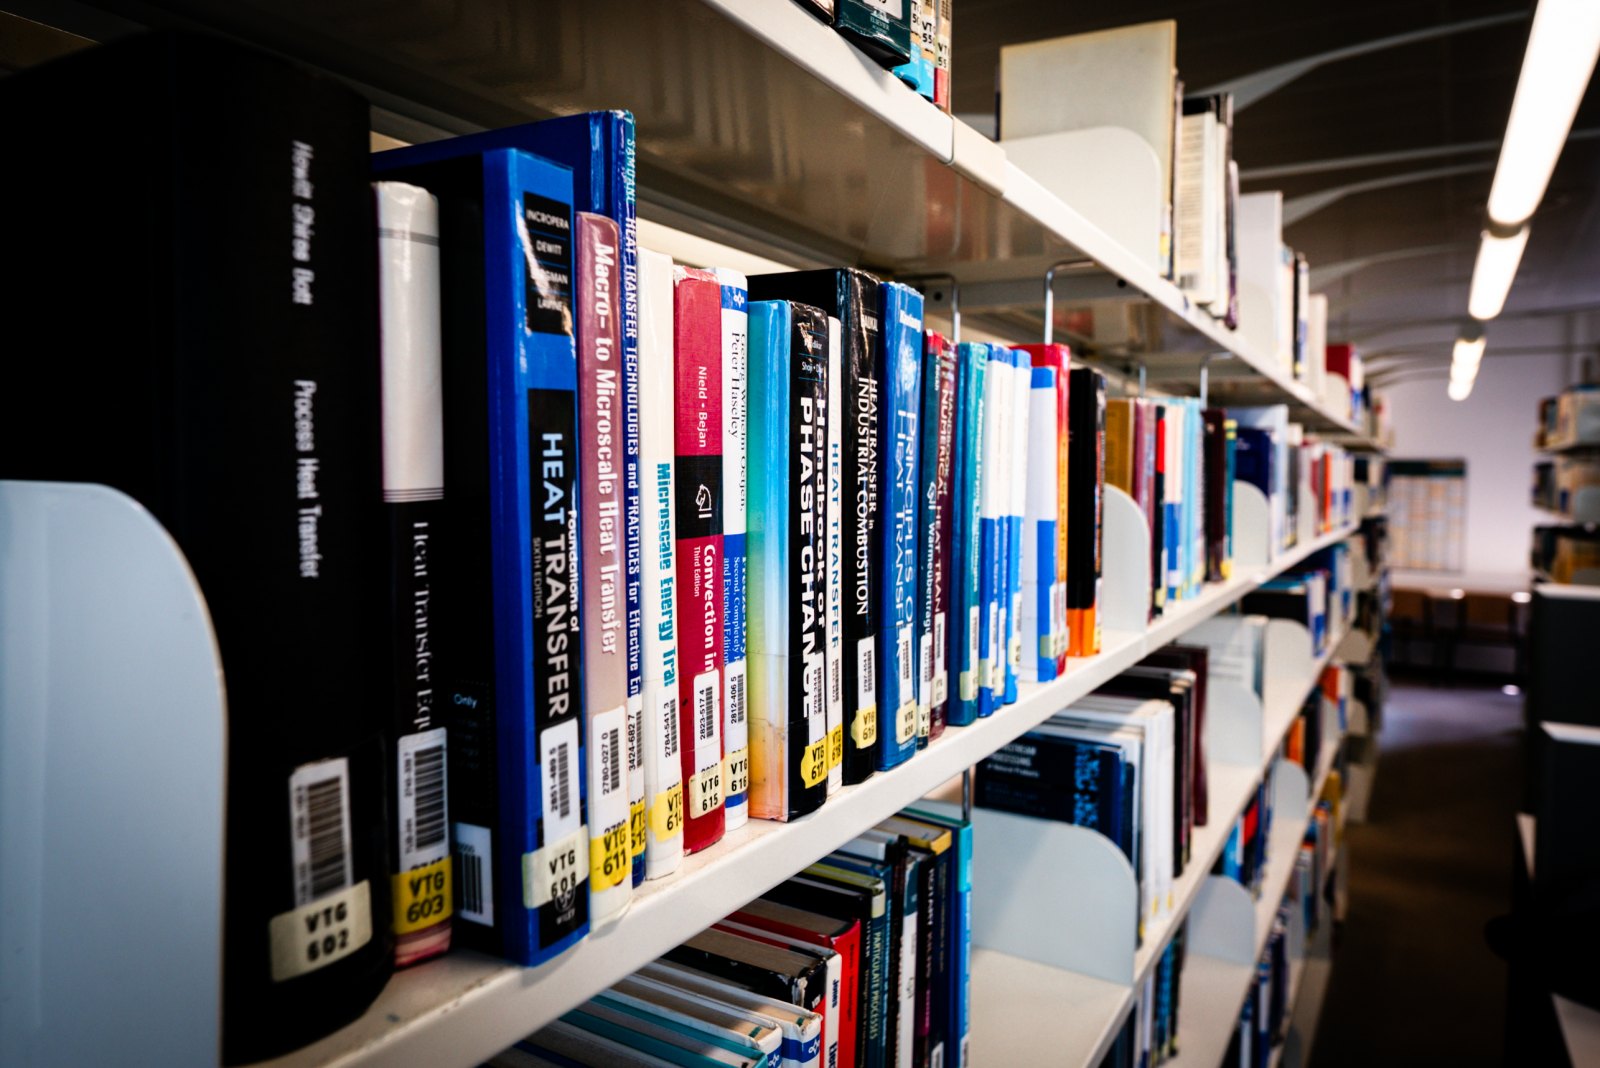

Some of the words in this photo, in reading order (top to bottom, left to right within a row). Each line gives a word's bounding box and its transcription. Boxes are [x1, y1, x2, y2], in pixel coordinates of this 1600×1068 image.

[526, 208, 570, 231] INCROPERA
[625, 216, 637, 263] HEAT
[625, 264, 638, 338] TRANSFER
[595, 337, 613, 362] to
[731, 332, 740, 371] Peter
[625, 347, 639, 456] TECHNOLOGIES
[698, 366, 708, 399] Nield
[868, 379, 879, 426] HEAT
[294, 378, 317, 451] Process
[596, 369, 618, 495] Microscale
[698, 412, 708, 448] Bejan
[728, 378, 740, 438] Haseley
[857, 377, 870, 485] INDUSTRIAL
[800, 397, 814, 536] PHASE
[894, 410, 906, 493] HEAT
[935, 388, 949, 500] NUMERICAL
[297, 457, 319, 499] Heat
[542, 433, 565, 525] HEAT
[627, 462, 638, 489] and
[816, 399, 826, 583] Handbook
[868, 427, 878, 512] TRANSFER
[656, 463, 671, 571] Microscale
[904, 412, 917, 582] PRINCIPLES
[298, 504, 322, 578] Transfer
[598, 501, 619, 555] Heat
[627, 495, 640, 575] PRACTICES
[868, 518, 876, 530] in
[934, 505, 943, 553] HEAT
[413, 522, 429, 577] Heat
[533, 537, 543, 568] SIXTH
[568, 510, 579, 612] Foundations
[856, 491, 869, 616] COMBUSTION
[534, 571, 543, 619] EDITION
[599, 561, 621, 655] Transfer
[628, 581, 640, 604] for
[658, 576, 674, 642] Energy
[703, 544, 716, 649] Convection
[723, 579, 731, 619] Extended
[905, 596, 914, 625] O
[934, 560, 942, 613] TRAN
[414, 583, 431, 683] Transfer
[544, 534, 569, 718] TRANSFER
[569, 617, 580, 632] of
[733, 597, 741, 653] Completely
[818, 594, 825, 628] of
[629, 609, 641, 672] Effective
[704, 652, 717, 671] in
[723, 620, 731, 667] Edition
[628, 714, 635, 722] 7
[602, 743, 610, 796] 2780-027
[628, 723, 636, 772] 3424-682
[730, 760, 748, 775] VTG
[811, 744, 825, 763] VTG
[811, 761, 825, 780] 617
[701, 775, 719, 794] VTG
[701, 792, 719, 812] 615
[549, 849, 576, 875] VTG
[603, 827, 627, 853] VTG
[603, 848, 627, 877] 611
[409, 870, 446, 899] VTG
[550, 871, 577, 897] 608
[305, 901, 348, 935] VTG
[406, 894, 445, 925] 603
[306, 928, 350, 963] 602
[871, 931, 882, 989] PARTICULATE
[869, 990, 880, 1040] PROCESSES
